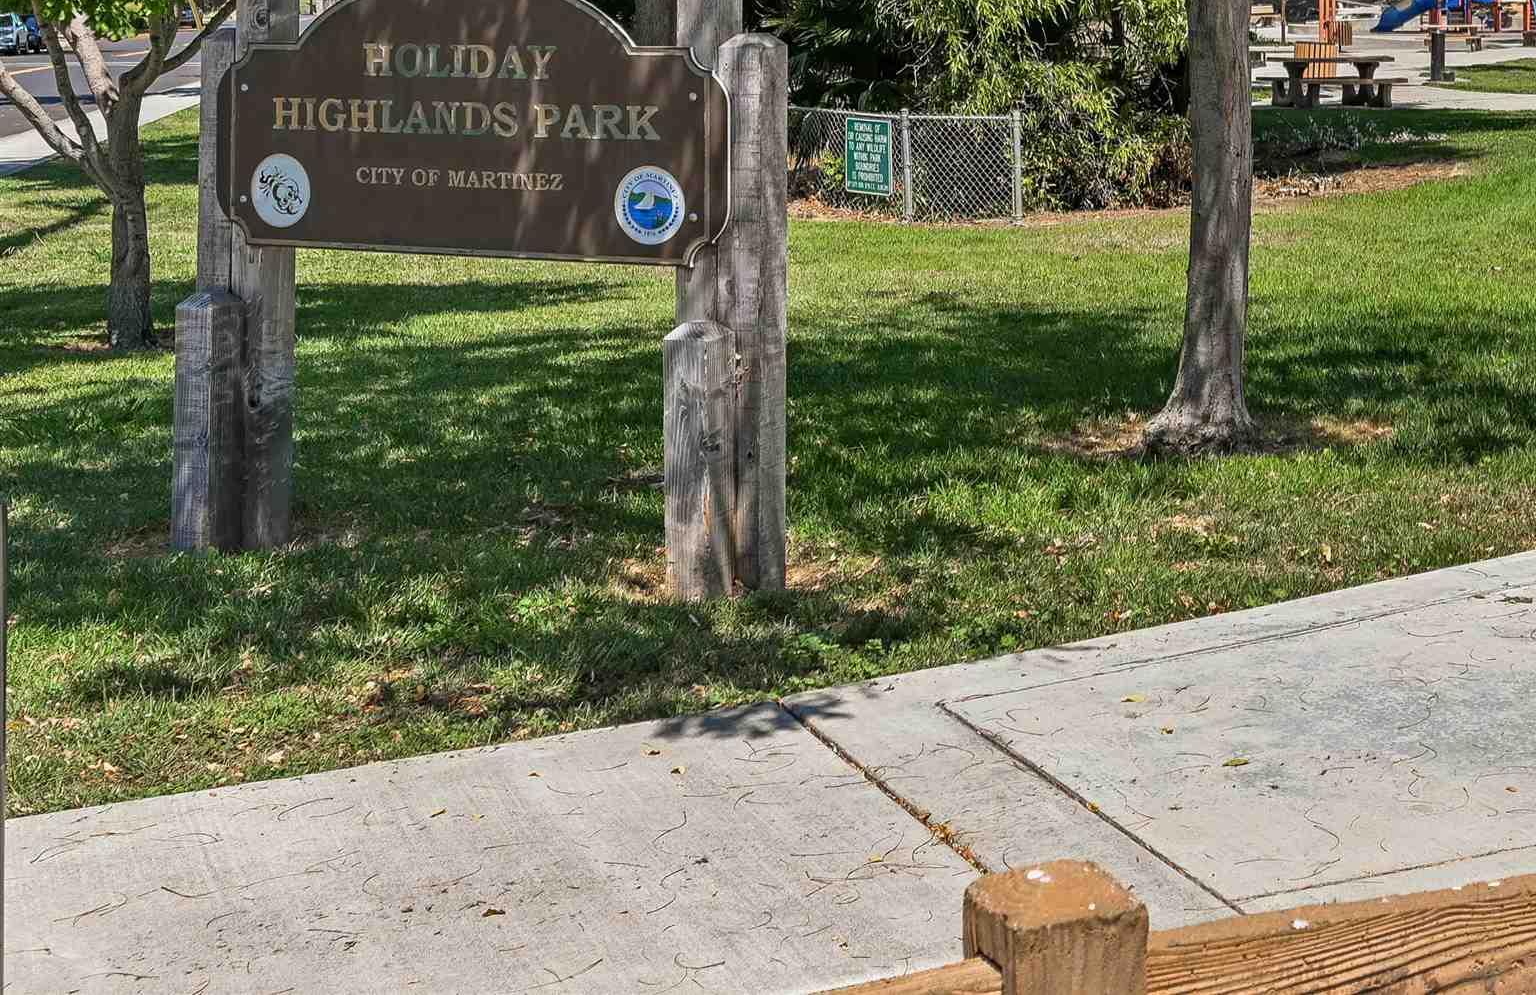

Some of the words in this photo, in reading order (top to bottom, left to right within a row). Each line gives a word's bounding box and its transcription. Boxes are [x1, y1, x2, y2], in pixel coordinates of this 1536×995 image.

[363, 41, 558, 81] HOLIDAY
[272, 96, 518, 138] HIGHLANDS
[534, 104, 660, 141] PARK
[856, 142, 865, 152] ANY
[866, 143, 886, 154] WILDLIFE
[356, 166, 406, 187] CITY
[411, 168, 440, 188] OF
[447, 169, 563, 192] MARTINEZ
[857, 171, 884, 183] PROHIBITED
